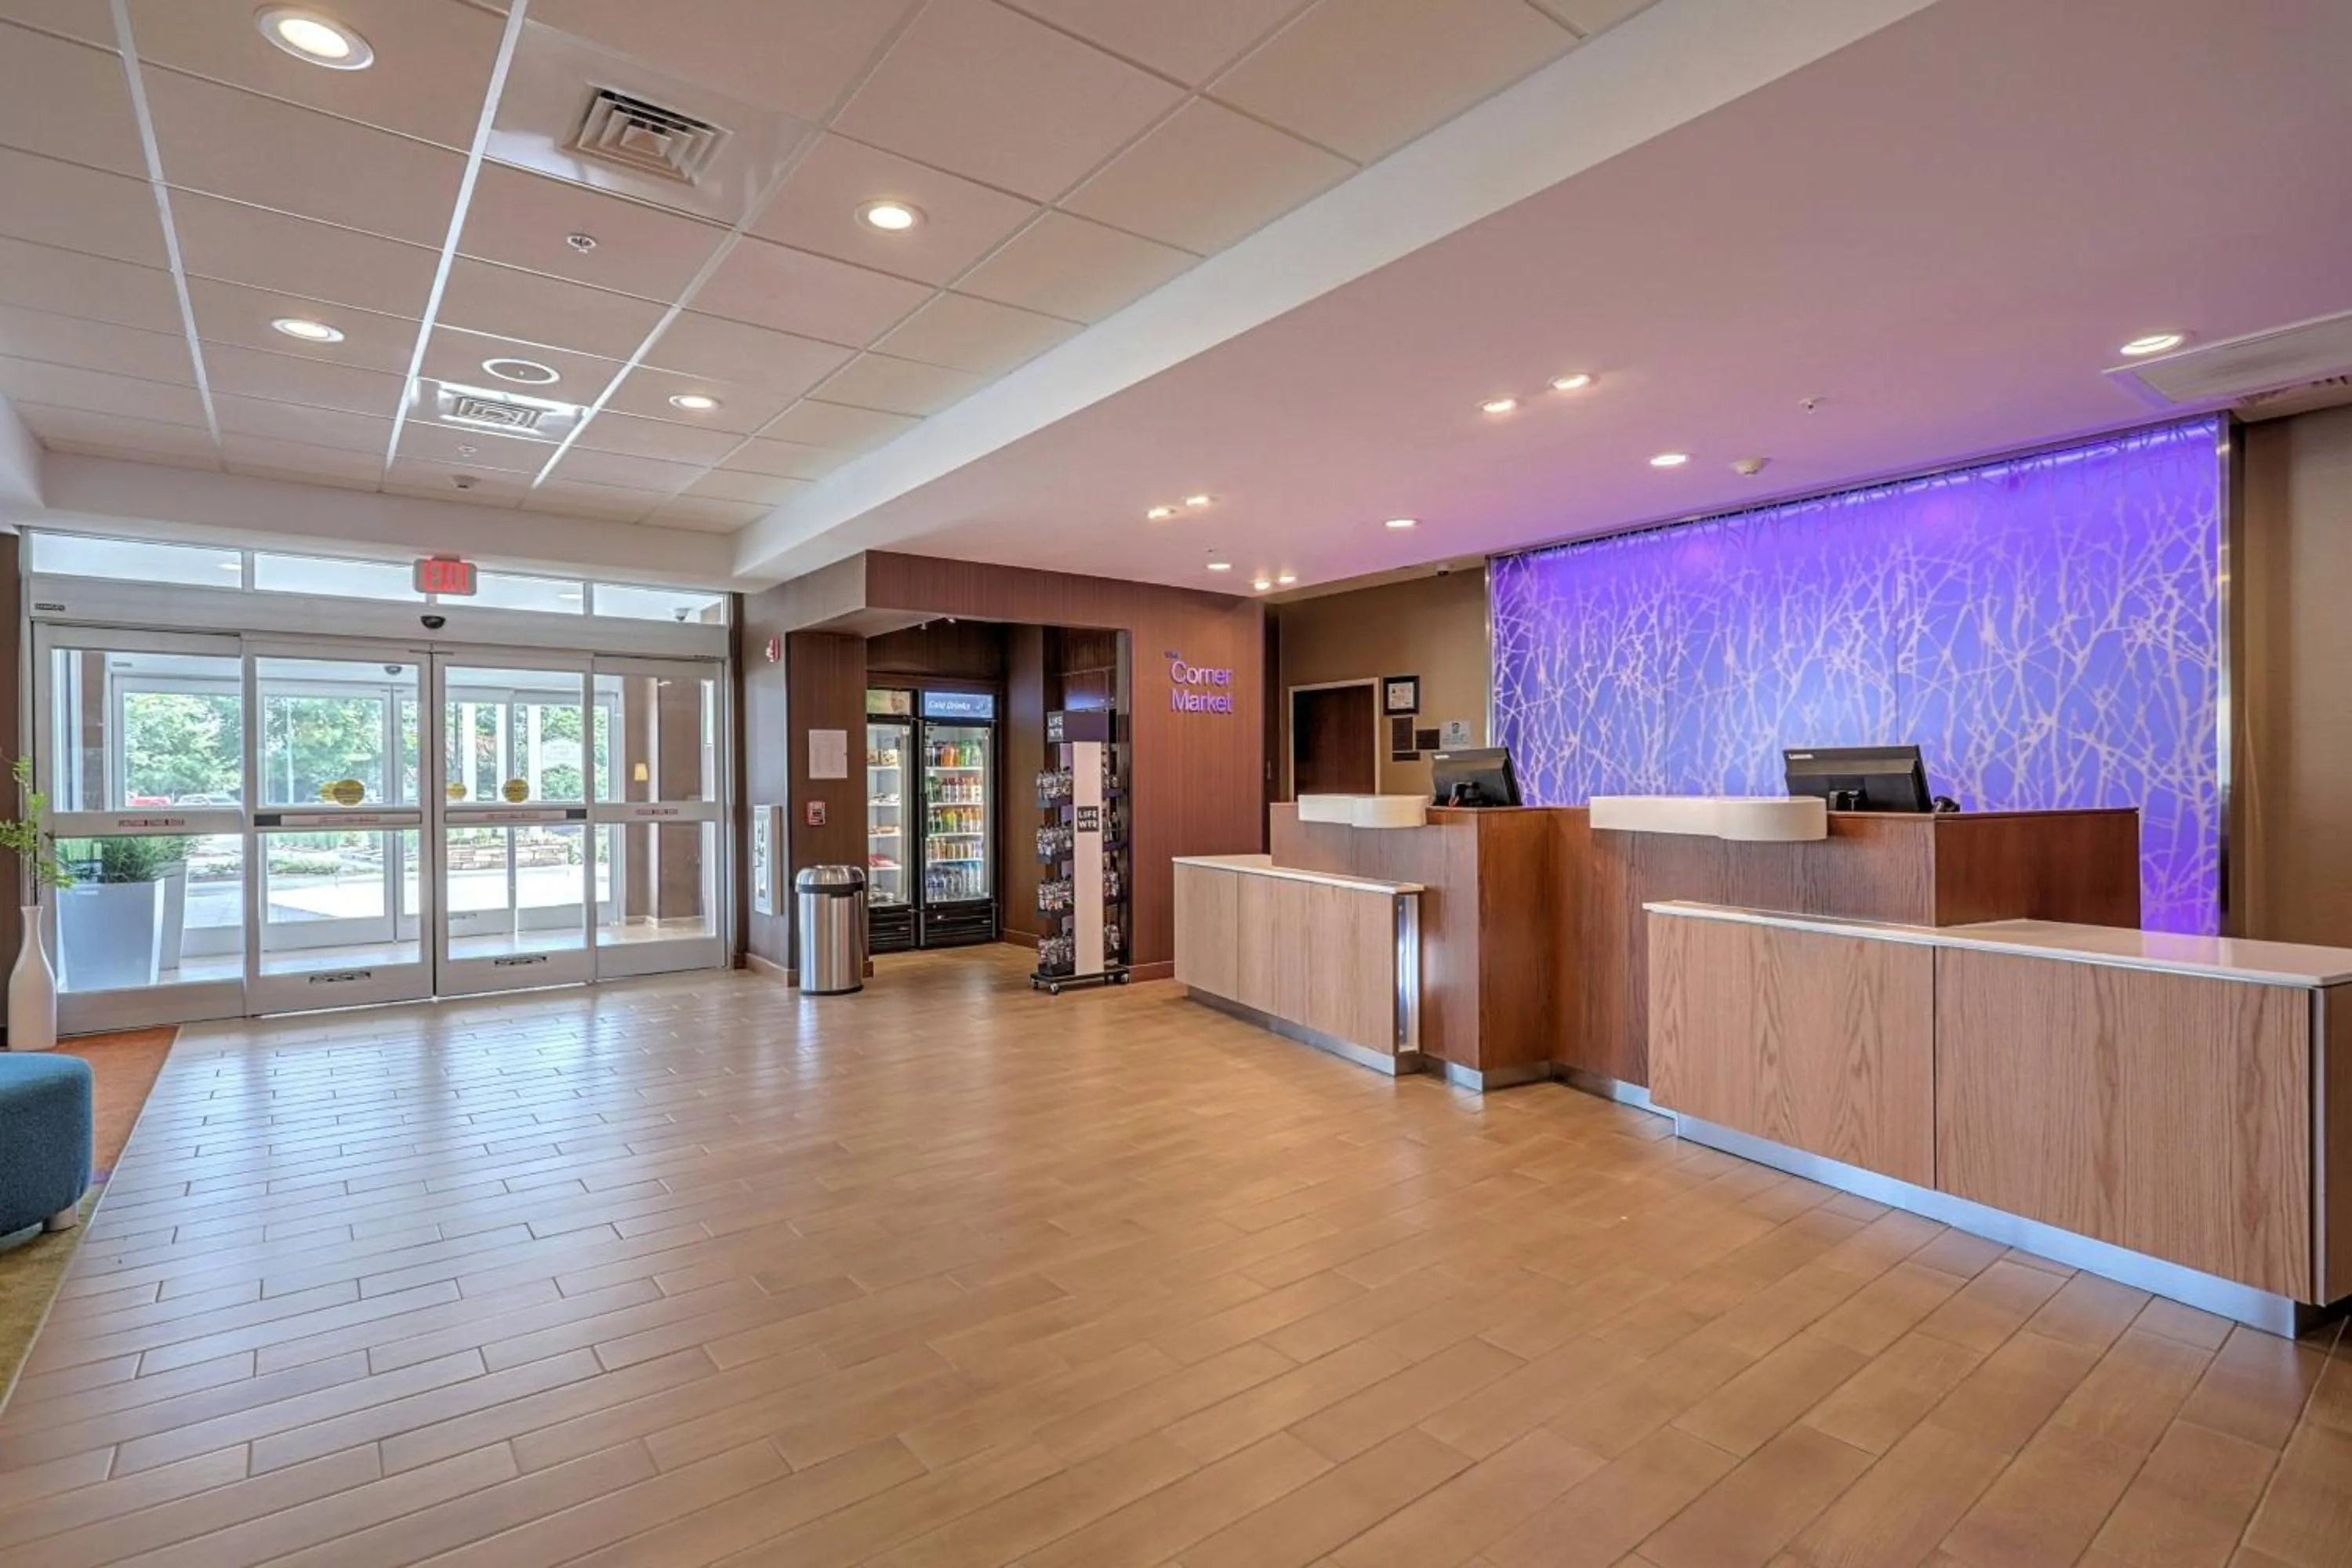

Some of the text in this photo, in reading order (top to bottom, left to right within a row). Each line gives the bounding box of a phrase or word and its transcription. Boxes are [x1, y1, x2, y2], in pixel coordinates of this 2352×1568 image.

[1171, 661, 1232, 686] Corner
[928, 700, 946, 710] Cold
[1171, 689, 1232, 714] Market
[1078, 810, 1098, 819] LIFE
[1078, 820, 1098, 829] WTR
